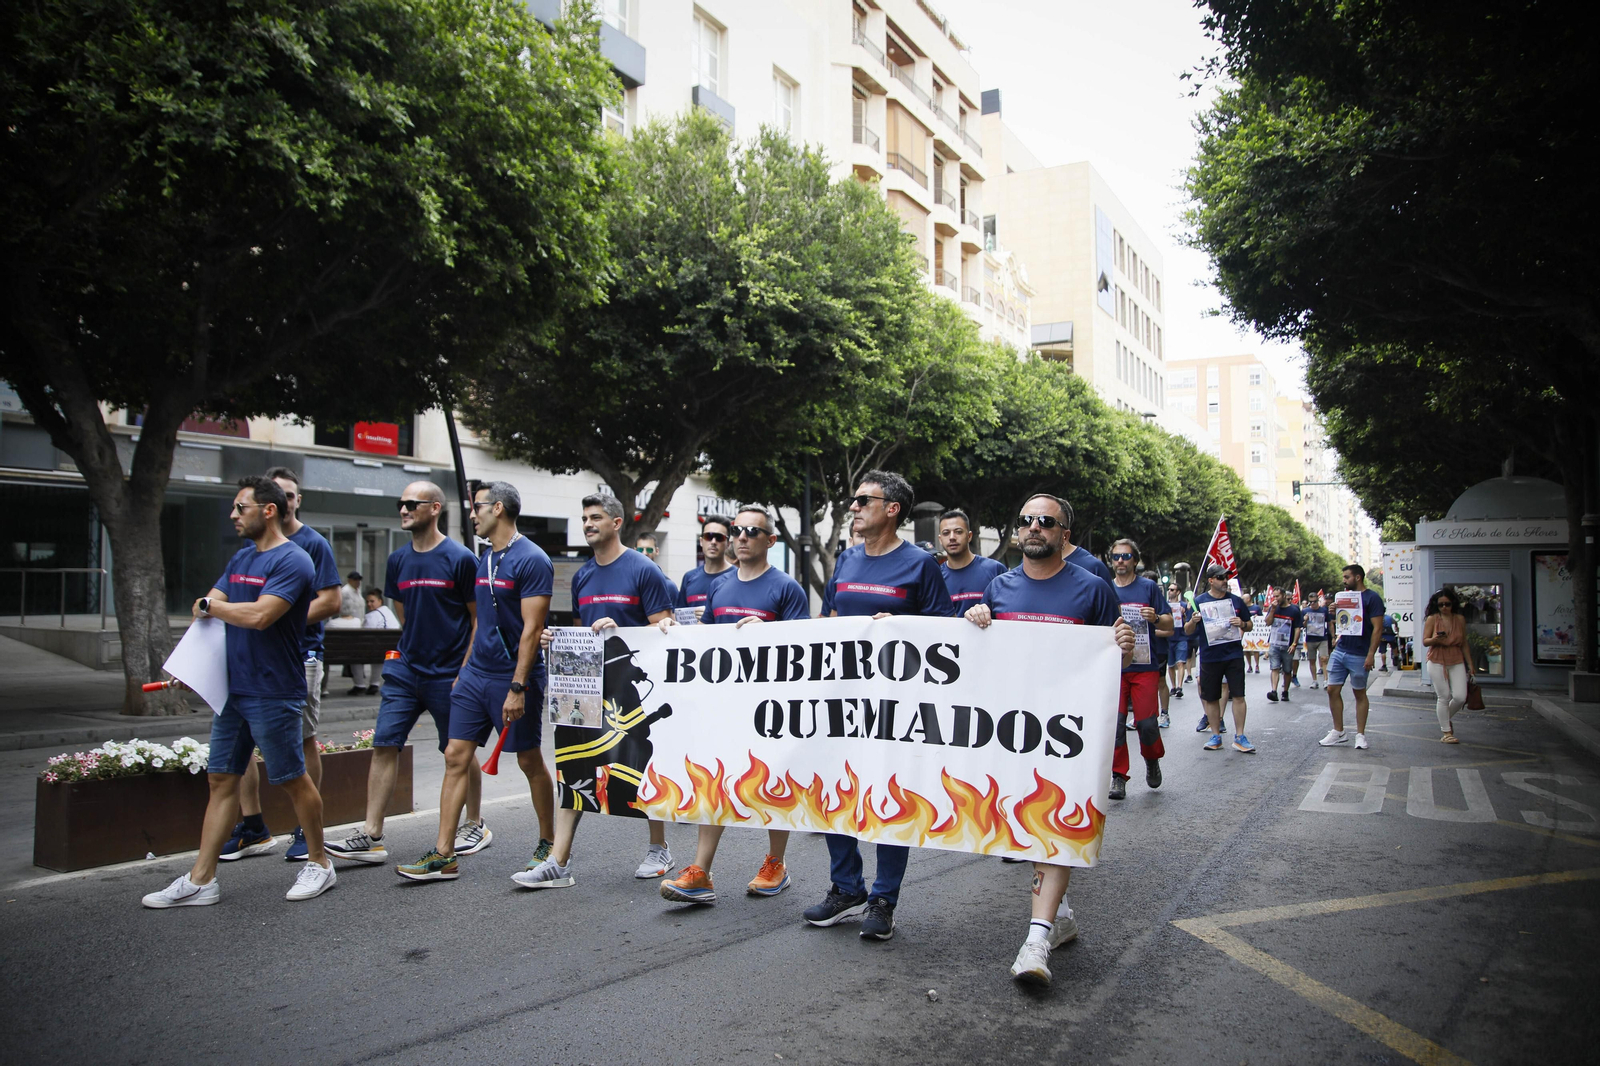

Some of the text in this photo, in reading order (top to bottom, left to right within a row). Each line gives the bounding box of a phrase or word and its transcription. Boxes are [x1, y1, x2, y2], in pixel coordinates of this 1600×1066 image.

[1433, 526, 1558, 539] El Kiosko de las Flores
[870, 586, 897, 594] BOMBEROS
[1044, 616, 1074, 624] BOMBEROS
[663, 640, 961, 685] BOMBEROS
[754, 698, 1084, 759] QUEMADOS
[1298, 762, 1599, 832] BUS
